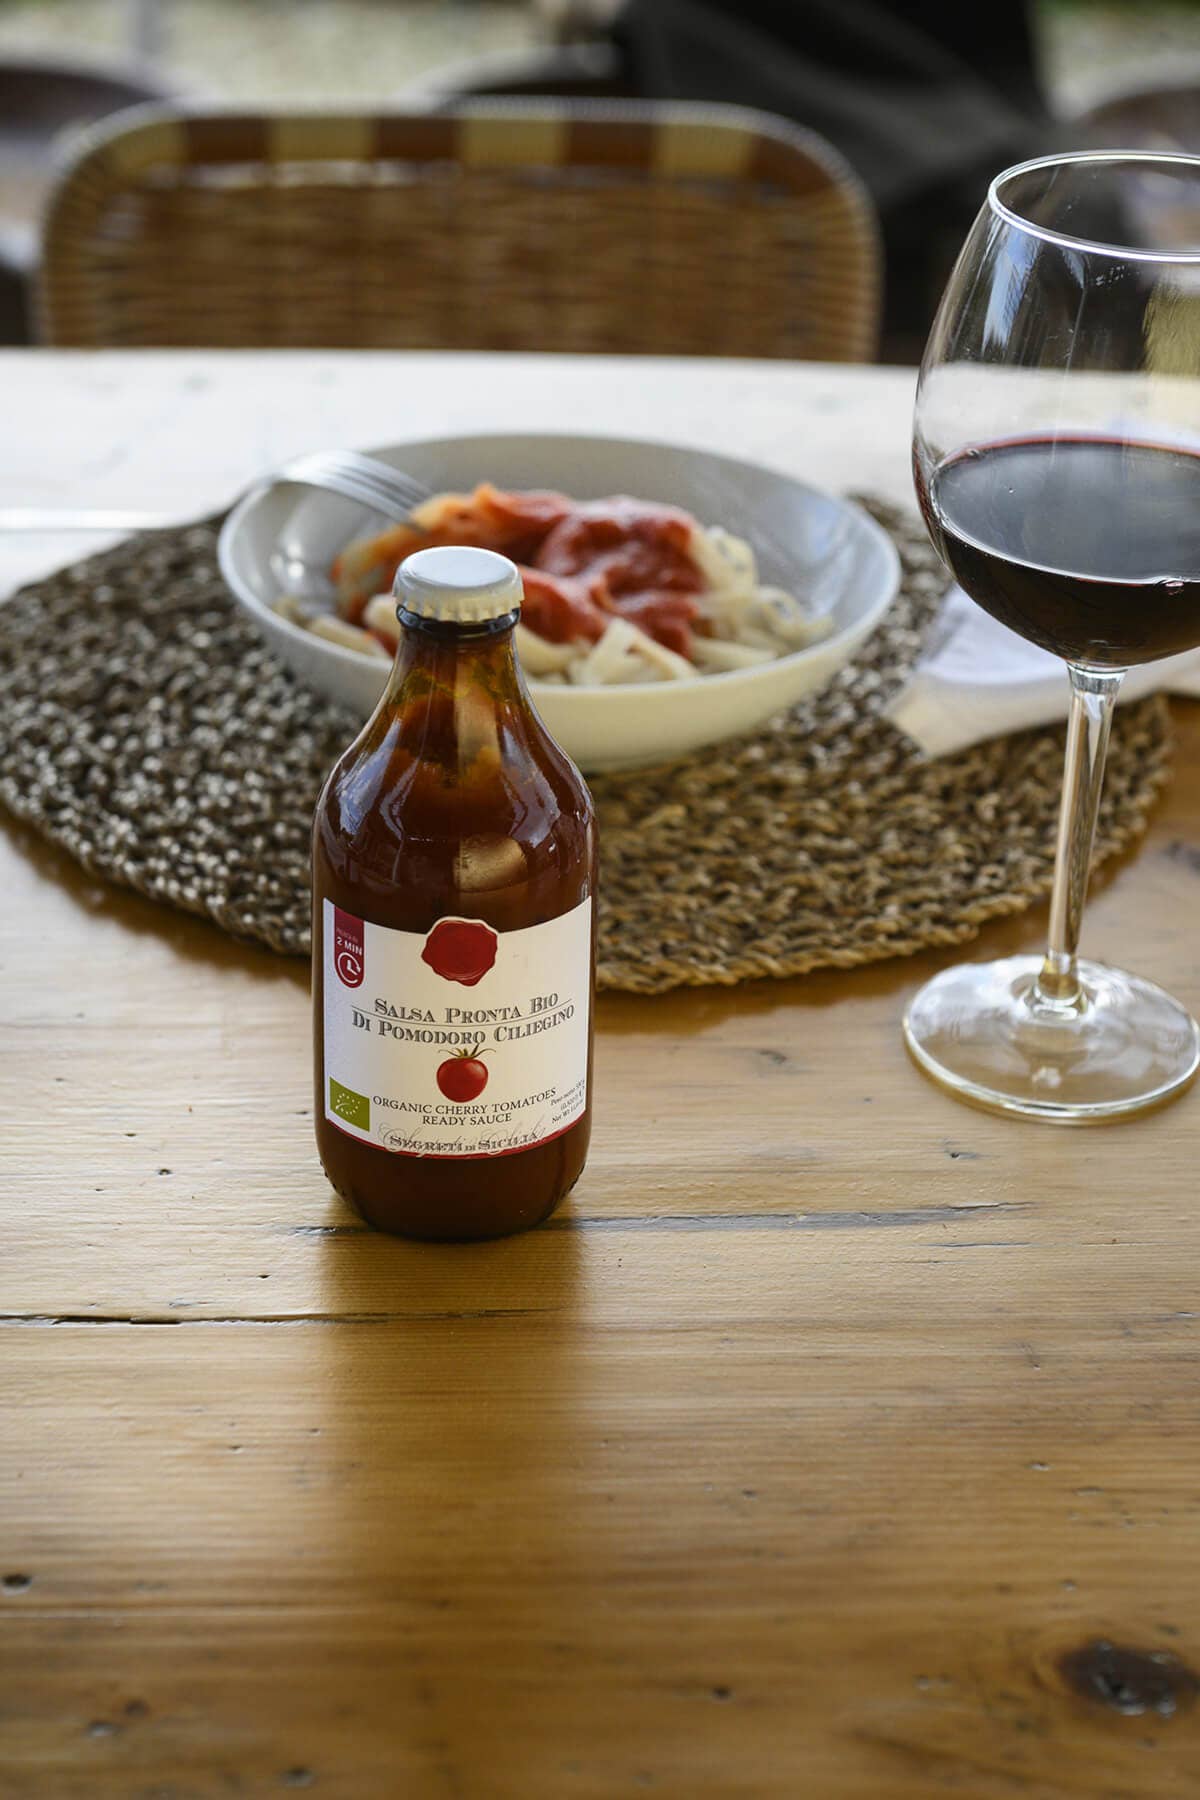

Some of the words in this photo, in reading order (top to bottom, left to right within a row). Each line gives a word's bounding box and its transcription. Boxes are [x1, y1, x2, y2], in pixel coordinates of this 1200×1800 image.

[336, 936, 343, 946] 2
[344, 940, 363, 956] MIN
[372, 1095, 433, 1114] ORGANIC
[435, 1104, 488, 1115] CHERRY
[491, 1087, 557, 1113] TOMATOES
[422, 1115, 467, 1126] READY
[469, 1112, 512, 1126] SAUCE
